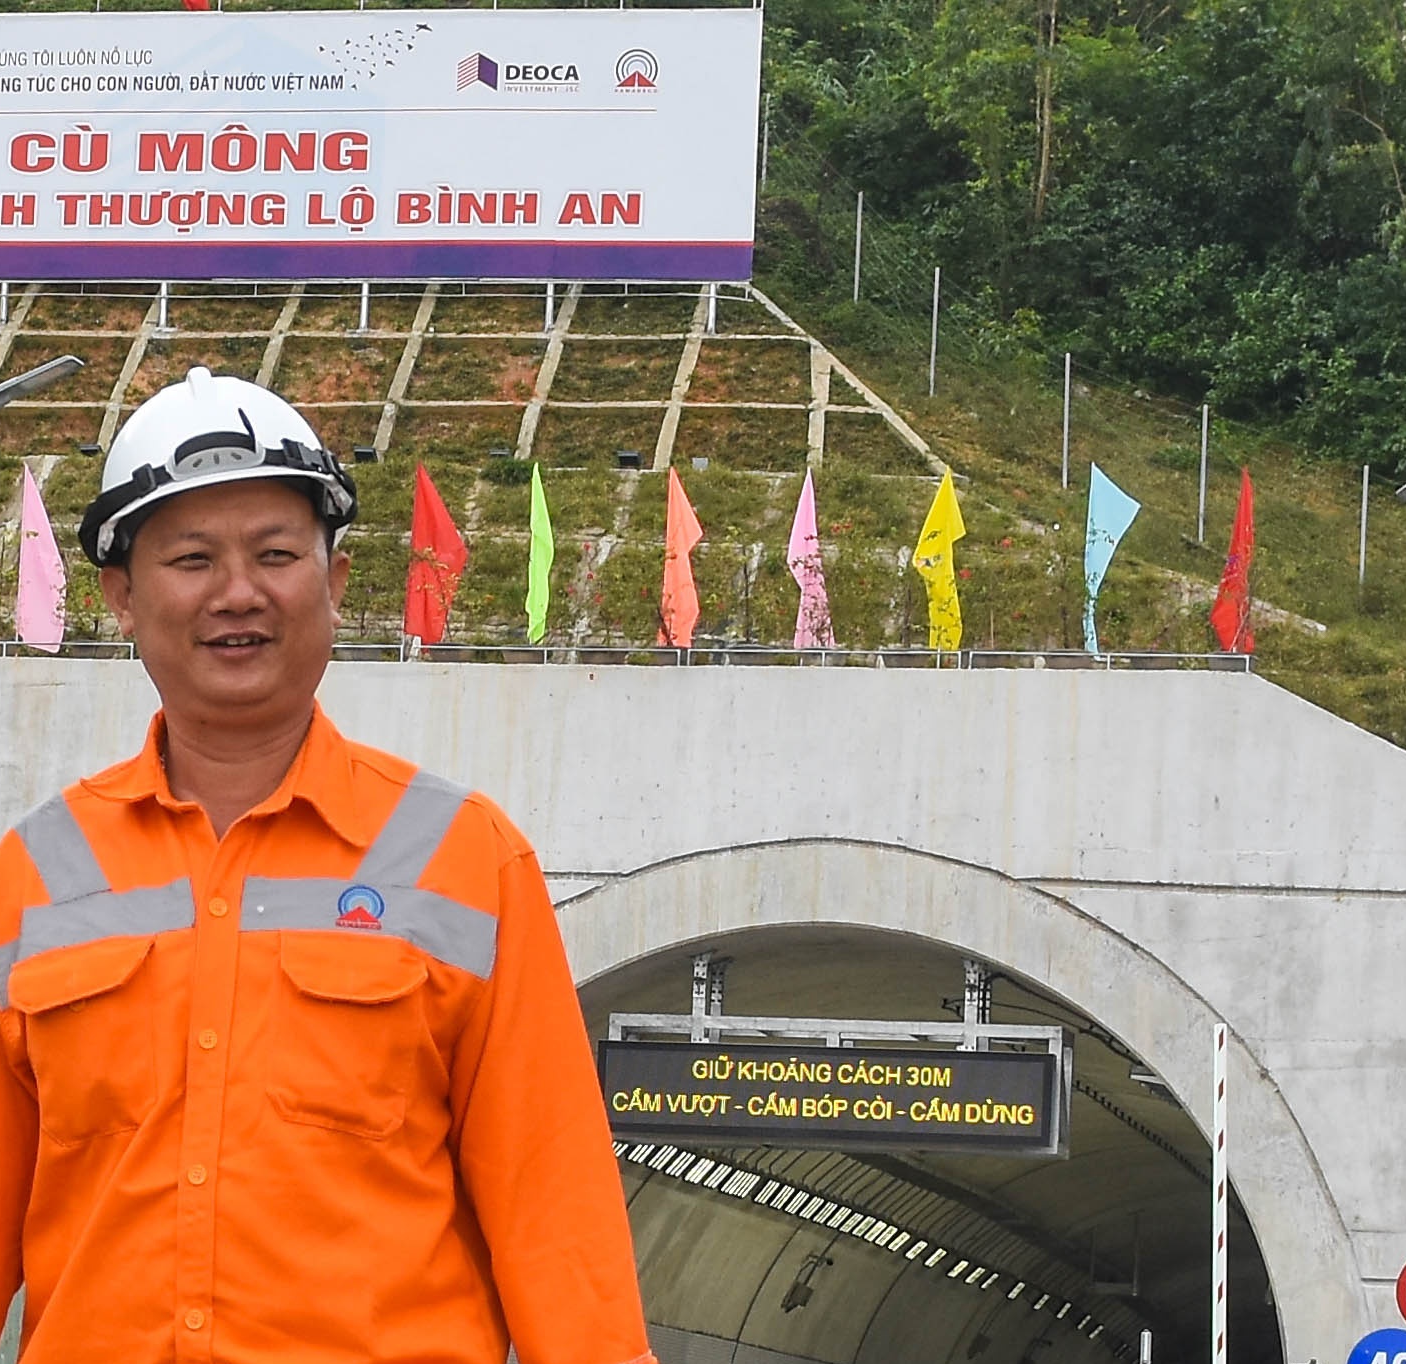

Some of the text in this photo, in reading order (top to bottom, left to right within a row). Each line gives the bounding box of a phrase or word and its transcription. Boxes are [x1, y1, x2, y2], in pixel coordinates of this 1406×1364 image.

[32, 50, 54, 66] TÔI
[58, 48, 96, 66] LUÔN
[125, 49, 153, 68] LỰC
[505, 64, 580, 81] DEOCA
[27, 74, 56, 92] TÚC
[61, 76, 92, 92] CHO
[97, 76, 128, 91] CON
[133, 72, 184, 93] NGƯỜI,
[189, 70, 219, 91] ĐẤT
[224, 72, 266, 91] NƯỚC
[271, 72, 305, 94] VIỆT
[309, 75, 344, 90] NAM
[9, 124, 112, 174] CÙ
[138, 124, 371, 174] MÔNG
[57, 190, 287, 234] THƯỢNG
[306, 186, 376, 233] LỘ
[397, 186, 539, 226] BÌNH
[557, 192, 643, 226] AN
[692, 1055, 952, 1087] GIỮ KHOẢNG CÁCH 30M
[612, 1088, 662, 1112] CẤM
[666, 1094, 731, 1117] VƯỢT
[747, 1092, 797, 1117] CẤM
[802, 1093, 848, 1118] BÓP
[853, 1095, 892, 1120] CÒI
[910, 1098, 960, 1122] CẤM
[965, 1098, 1034, 1125] DỪNG
